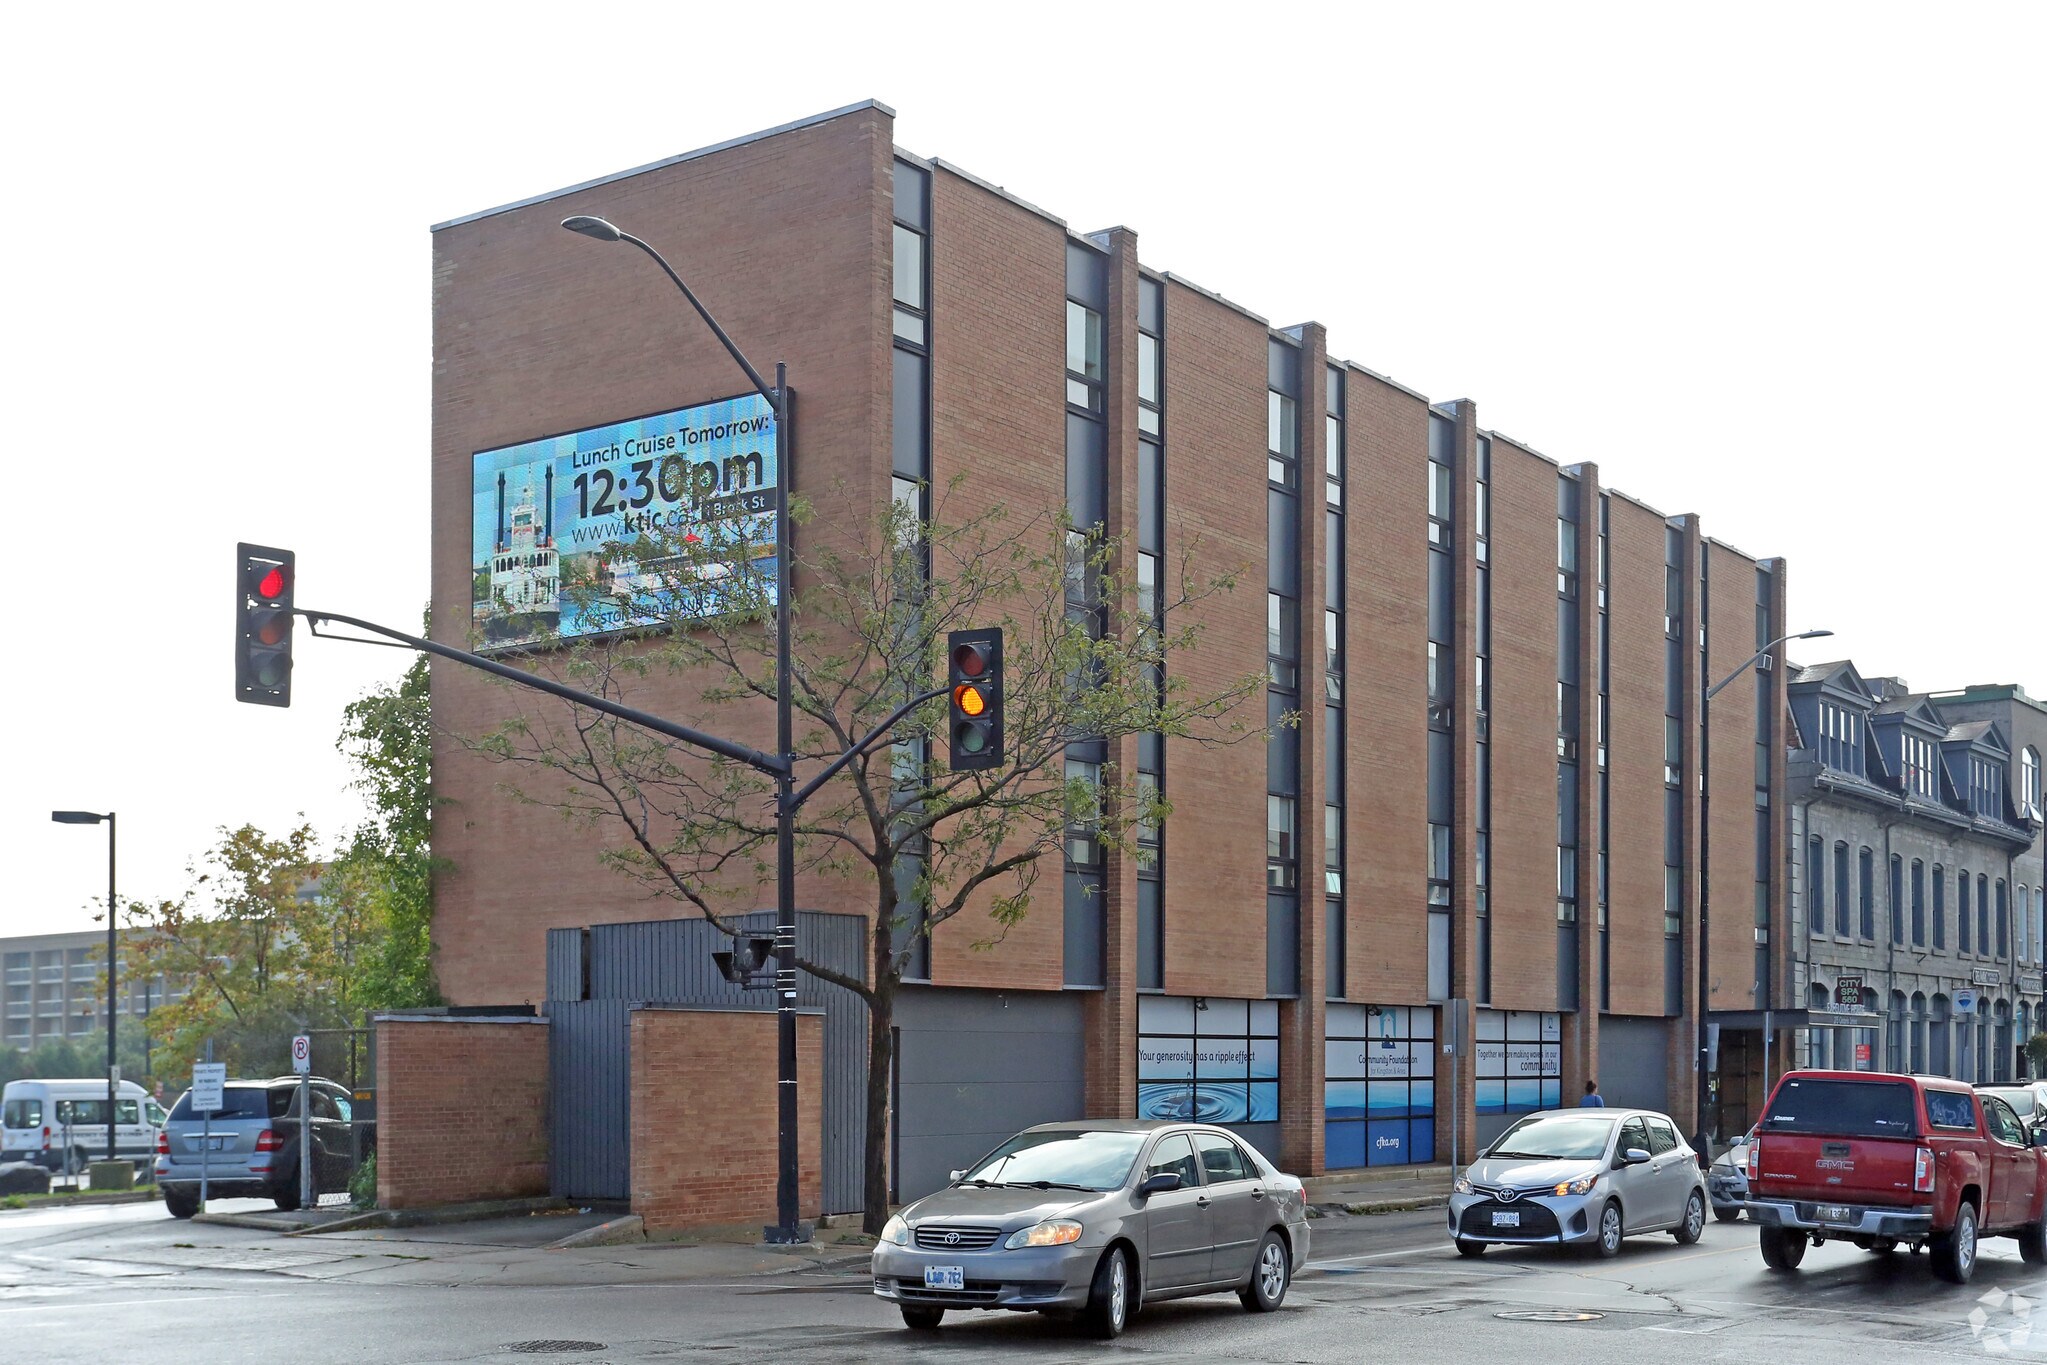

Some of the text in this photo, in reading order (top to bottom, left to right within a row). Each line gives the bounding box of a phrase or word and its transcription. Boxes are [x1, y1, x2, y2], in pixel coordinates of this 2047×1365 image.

[573, 415, 770, 469] Lunch Cruise Tomorrow:
[573, 450, 764, 520] 12:30pm
[751, 494, 766, 510] St
[1839, 979, 1861, 987] CITY
[1840, 988, 1859, 996] SPA
[1841, 996, 1858, 1004] 560
[1139, 1050, 1155, 1061] Your
[1156, 1050, 1194, 1064] generosity
[1208, 1052, 1214, 1061] a
[1215, 1049, 1235, 1064] ripple
[1477, 1048, 1498, 1060] Together
[1513, 1050, 1530, 1060] making
[1815, 1159, 1855, 1171] GMC
[1763, 1172, 1797, 1180] CANYON
